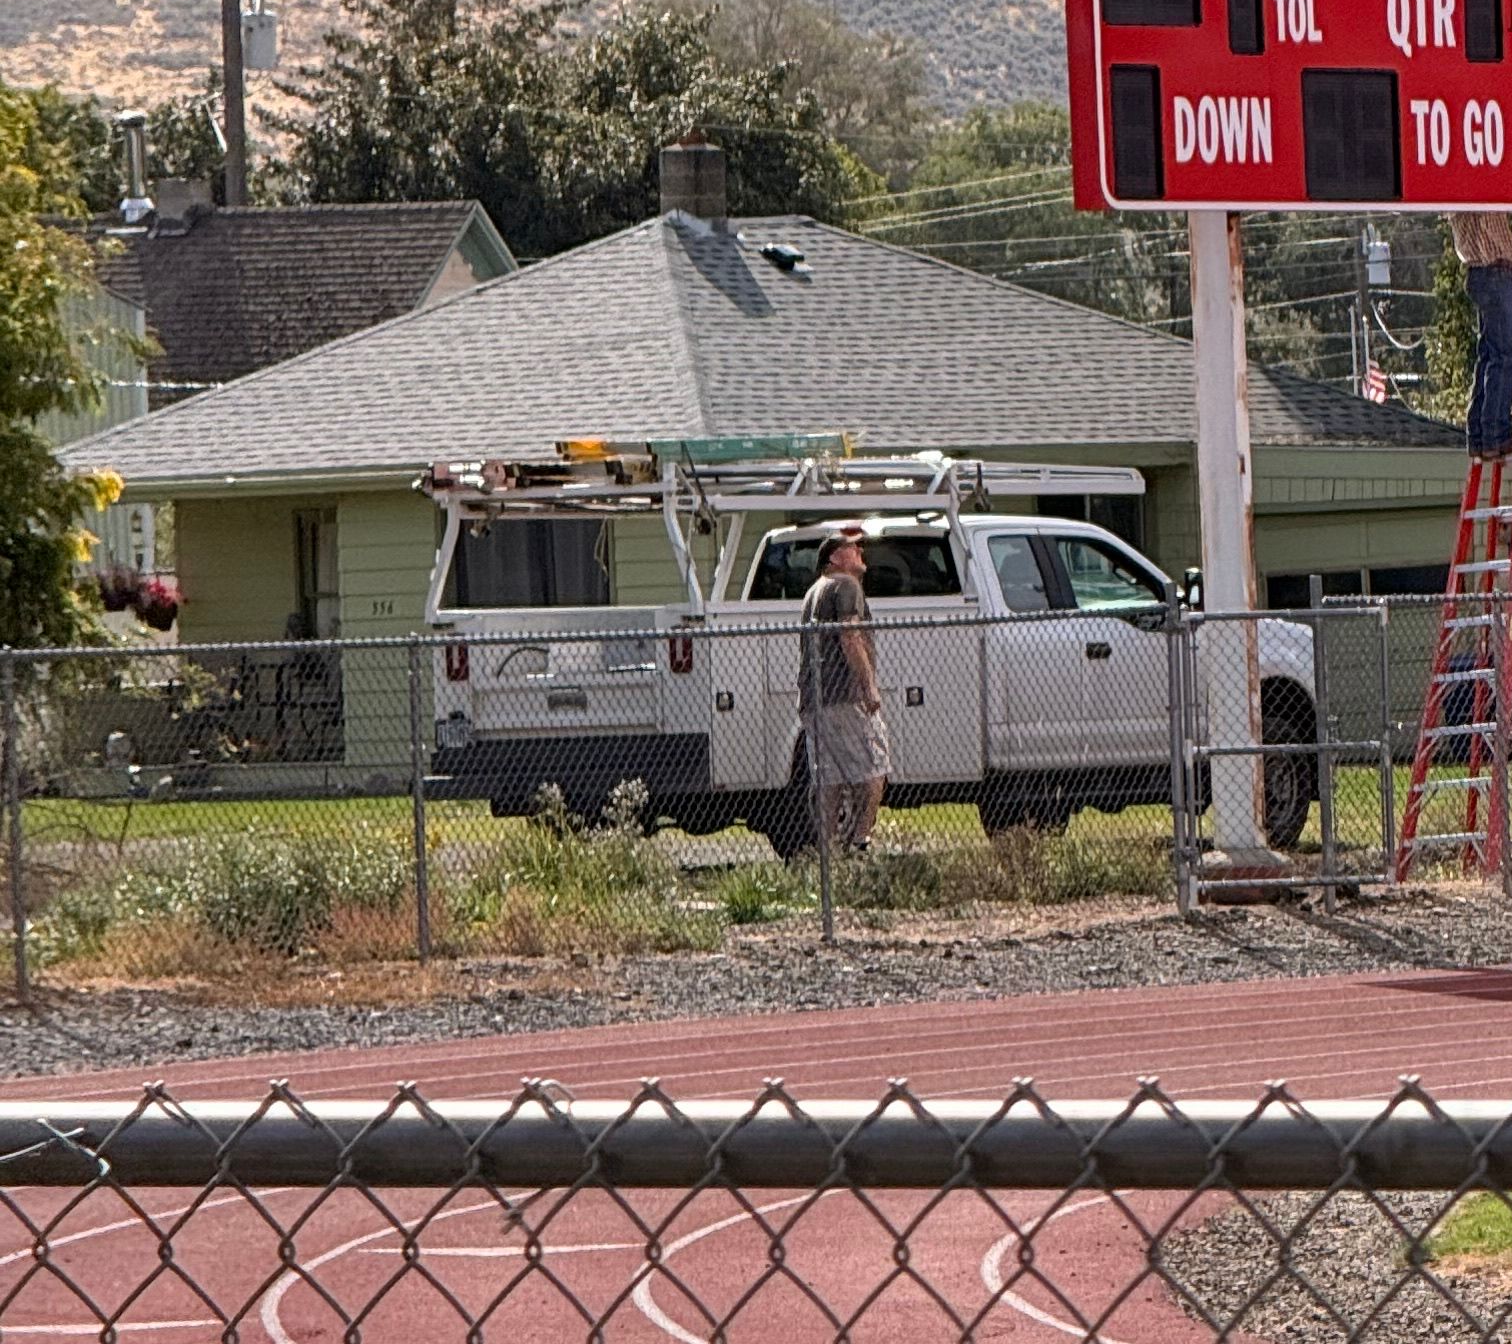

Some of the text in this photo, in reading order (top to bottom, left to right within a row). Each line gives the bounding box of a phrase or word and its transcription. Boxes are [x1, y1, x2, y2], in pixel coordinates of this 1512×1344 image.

[1174, 96, 1272, 164] DOWN
[1411, 99, 1503, 167] TO GO
